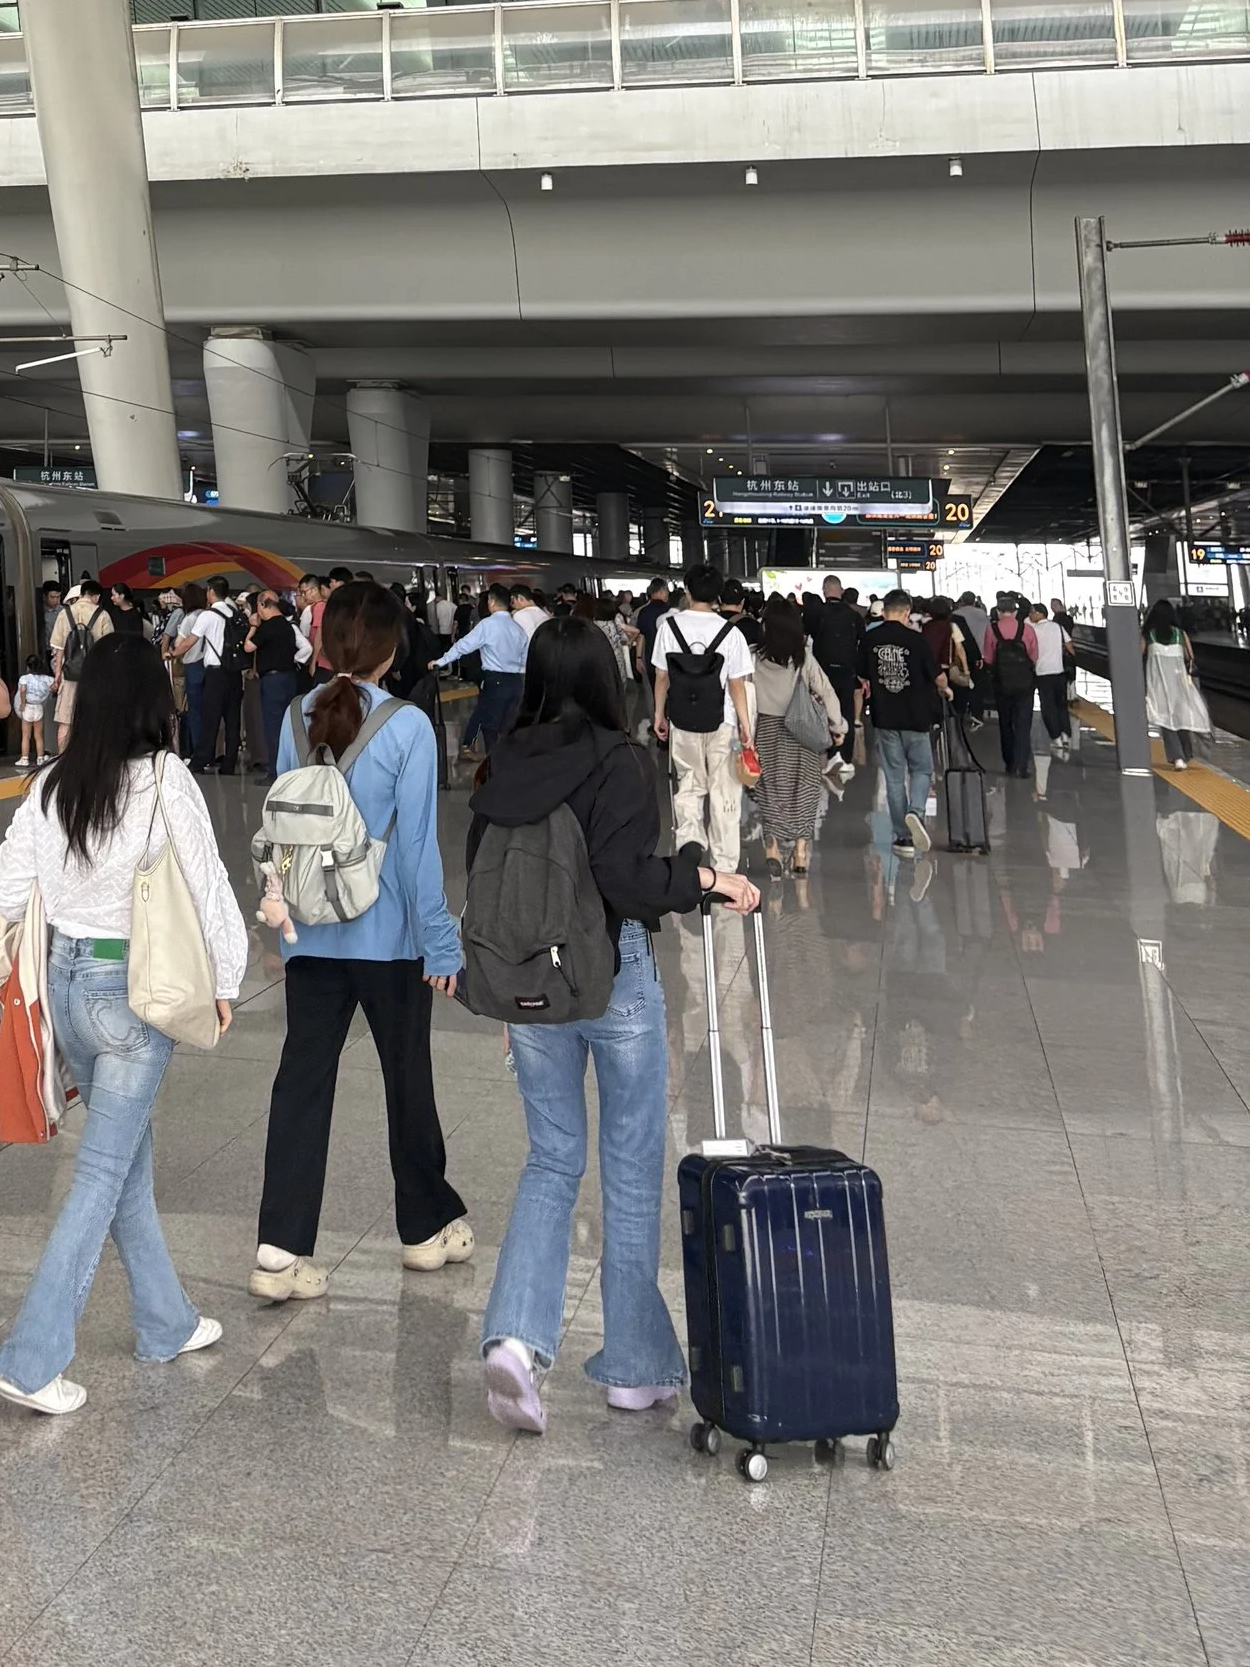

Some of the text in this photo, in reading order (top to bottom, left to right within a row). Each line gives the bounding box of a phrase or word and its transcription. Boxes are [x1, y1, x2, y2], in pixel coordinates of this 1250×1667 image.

[40, 470, 84, 481] 杭州东站
[746, 479, 799, 491] 杭州东站
[856, 480, 891, 492] 出站口
[944, 503, 970, 521] 20
[929, 544, 943, 556] 20
[1191, 548, 1206, 560] 19
[925, 561, 936, 570] 20
